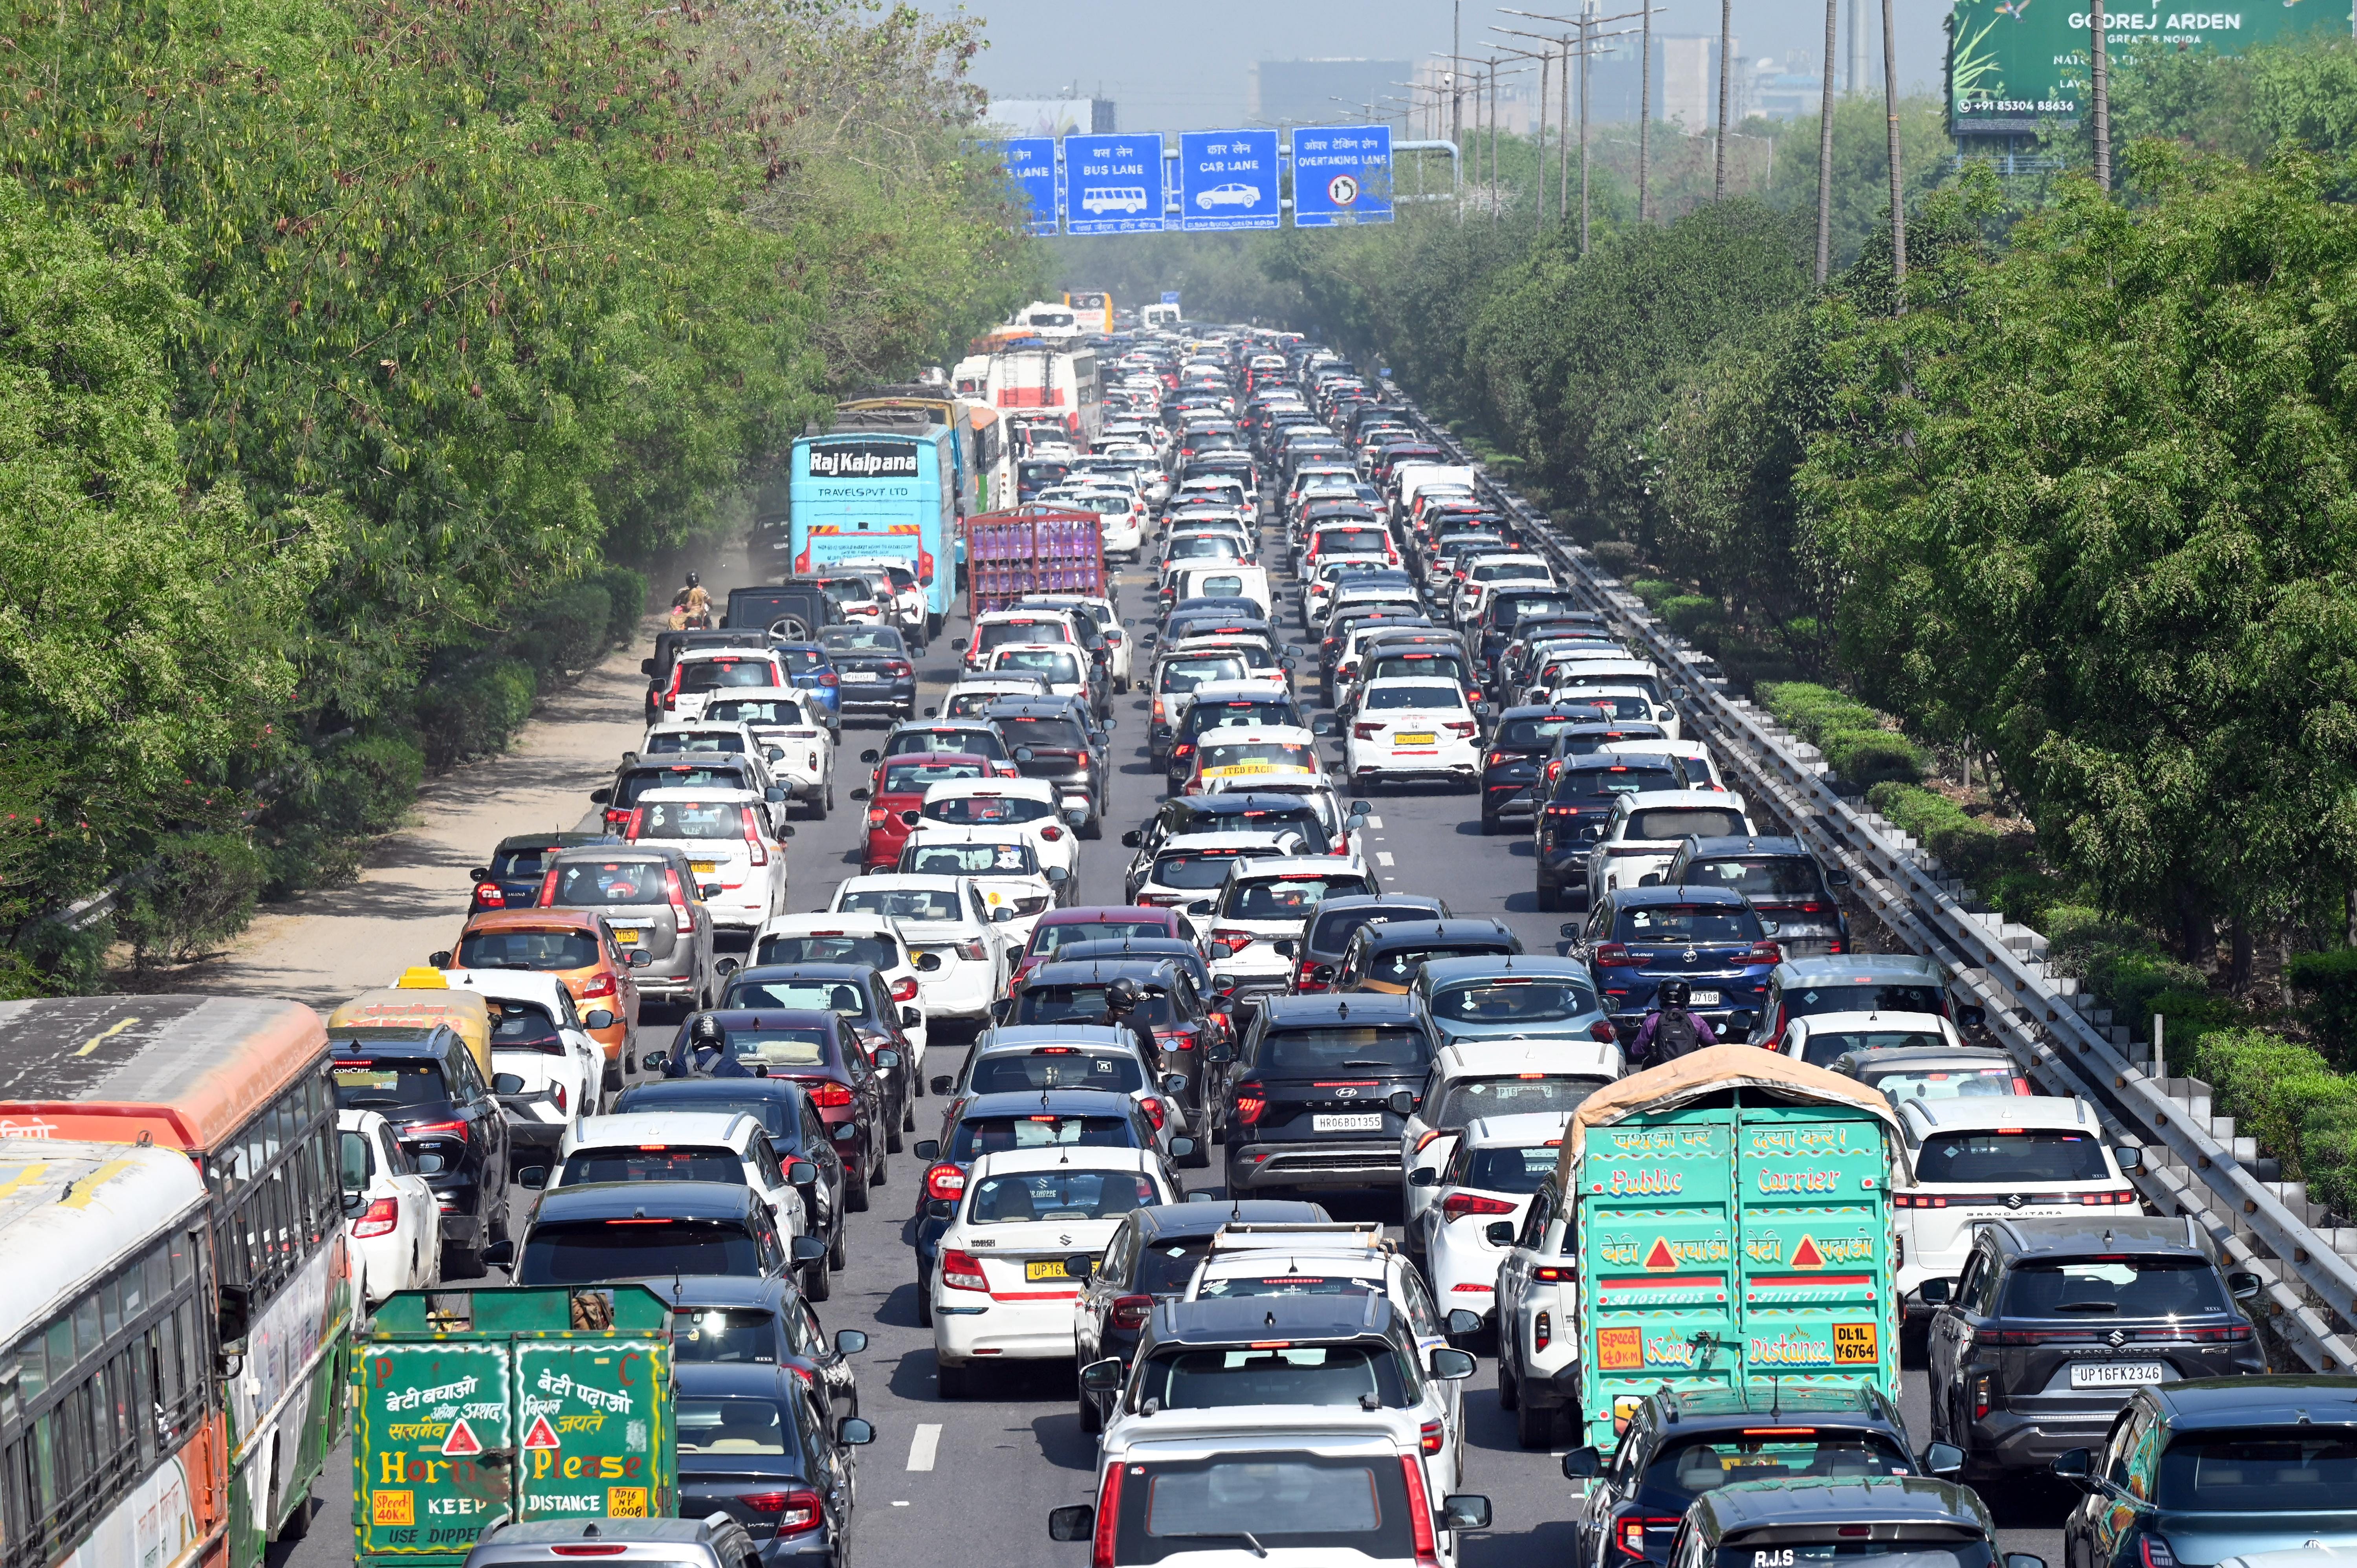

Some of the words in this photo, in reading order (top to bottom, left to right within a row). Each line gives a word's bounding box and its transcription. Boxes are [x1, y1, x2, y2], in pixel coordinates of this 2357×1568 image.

[2165, 13, 2240, 29] ARDEN
[2163, 34, 2201, 44] NOIDA
[1974, 101, 1993, 111] +91
[1997, 101, 2034, 112] 85304
[2037, 100, 2075, 112] 88636
[1115, 145, 1133, 157] लेन
[1207, 144, 1227, 155] कार
[1231, 141, 1251, 154] लेन
[1361, 137, 1378, 149] लेन
[1200, 161, 1224, 172] CAR
[1228, 160, 1259, 171] LANE
[1298, 156, 1358, 167] OVERTAKING
[1361, 154, 1387, 165] LANE
[1017, 167, 1049, 178] LANE
[1083, 165, 1109, 176] BUS
[1112, 164, 1144, 175] LANE
[890, 488, 908, 496] LTD
[990, 895, 998, 904] 3
[1692, 993, 1718, 1002] J7108
[1320, 1118, 1380, 1128] HR06BD1355
[1679, 1129, 1712, 1148] पर
[1751, 1129, 1798, 1150] दया
[1607, 1169, 1683, 1196] Public
[1758, 1167, 1842, 1195] Carrier
[1600, 1232, 1641, 1266] बेटी
[1745, 1229, 1783, 1265] बेटी
[1645, 1336, 1695, 1367] Keep
[374, 1357, 393, 1388] P
[618, 1352, 640, 1386] C
[2081, 1367, 2159, 1381] UP16FK2346
[537, 1368, 575, 1397] बेटी
[385, 1390, 420, 1412] बेटी
[421, 1375, 479, 1405] बचाओ
[554, 1409, 609, 1435] जयते
[379, 1451, 476, 1484] Horn
[532, 1448, 642, 1480] Please
[428, 1498, 487, 1515] KEEP
[528, 1494, 601, 1512] DISTANCE
[612, 1506, 643, 1518] 0908
[389, 1528, 420, 1543] USE
